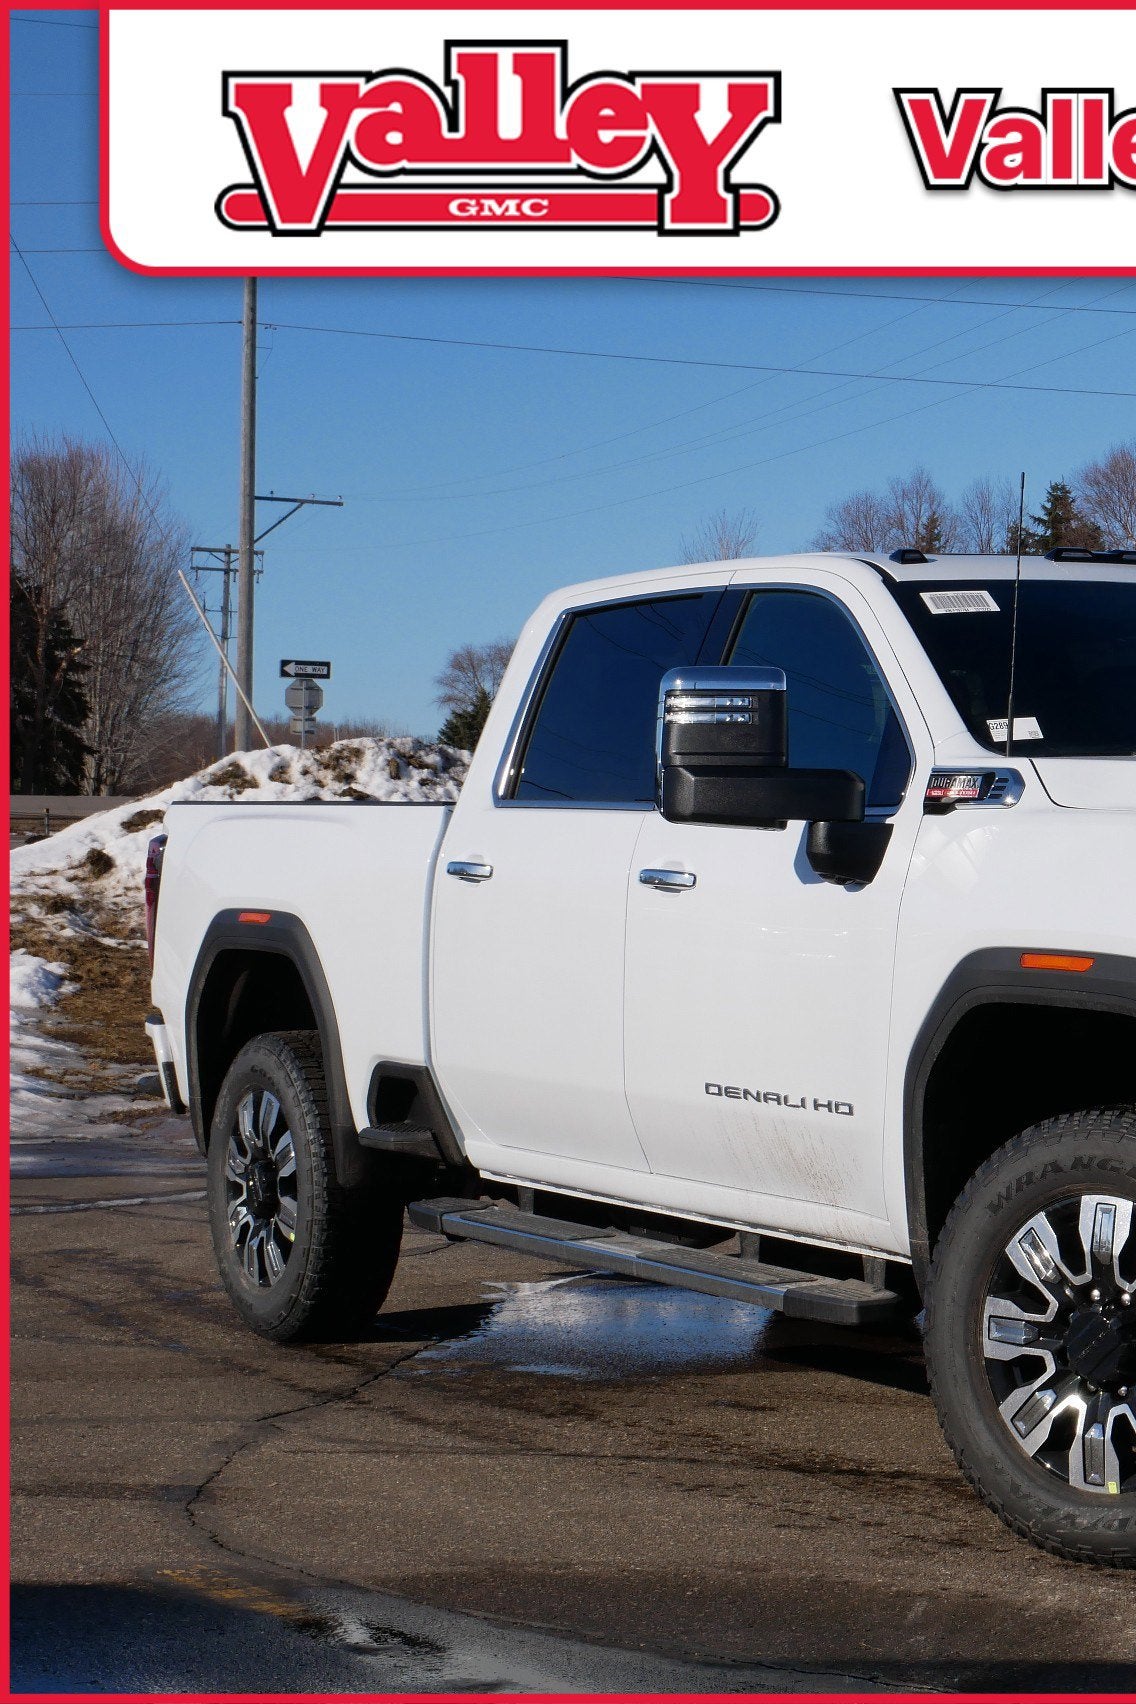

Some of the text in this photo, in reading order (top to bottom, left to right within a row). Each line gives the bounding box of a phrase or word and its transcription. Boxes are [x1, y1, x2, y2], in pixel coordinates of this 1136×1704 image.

[294, 665, 309, 673] ONE
[704, 1082, 854, 1117] DENALI HD
